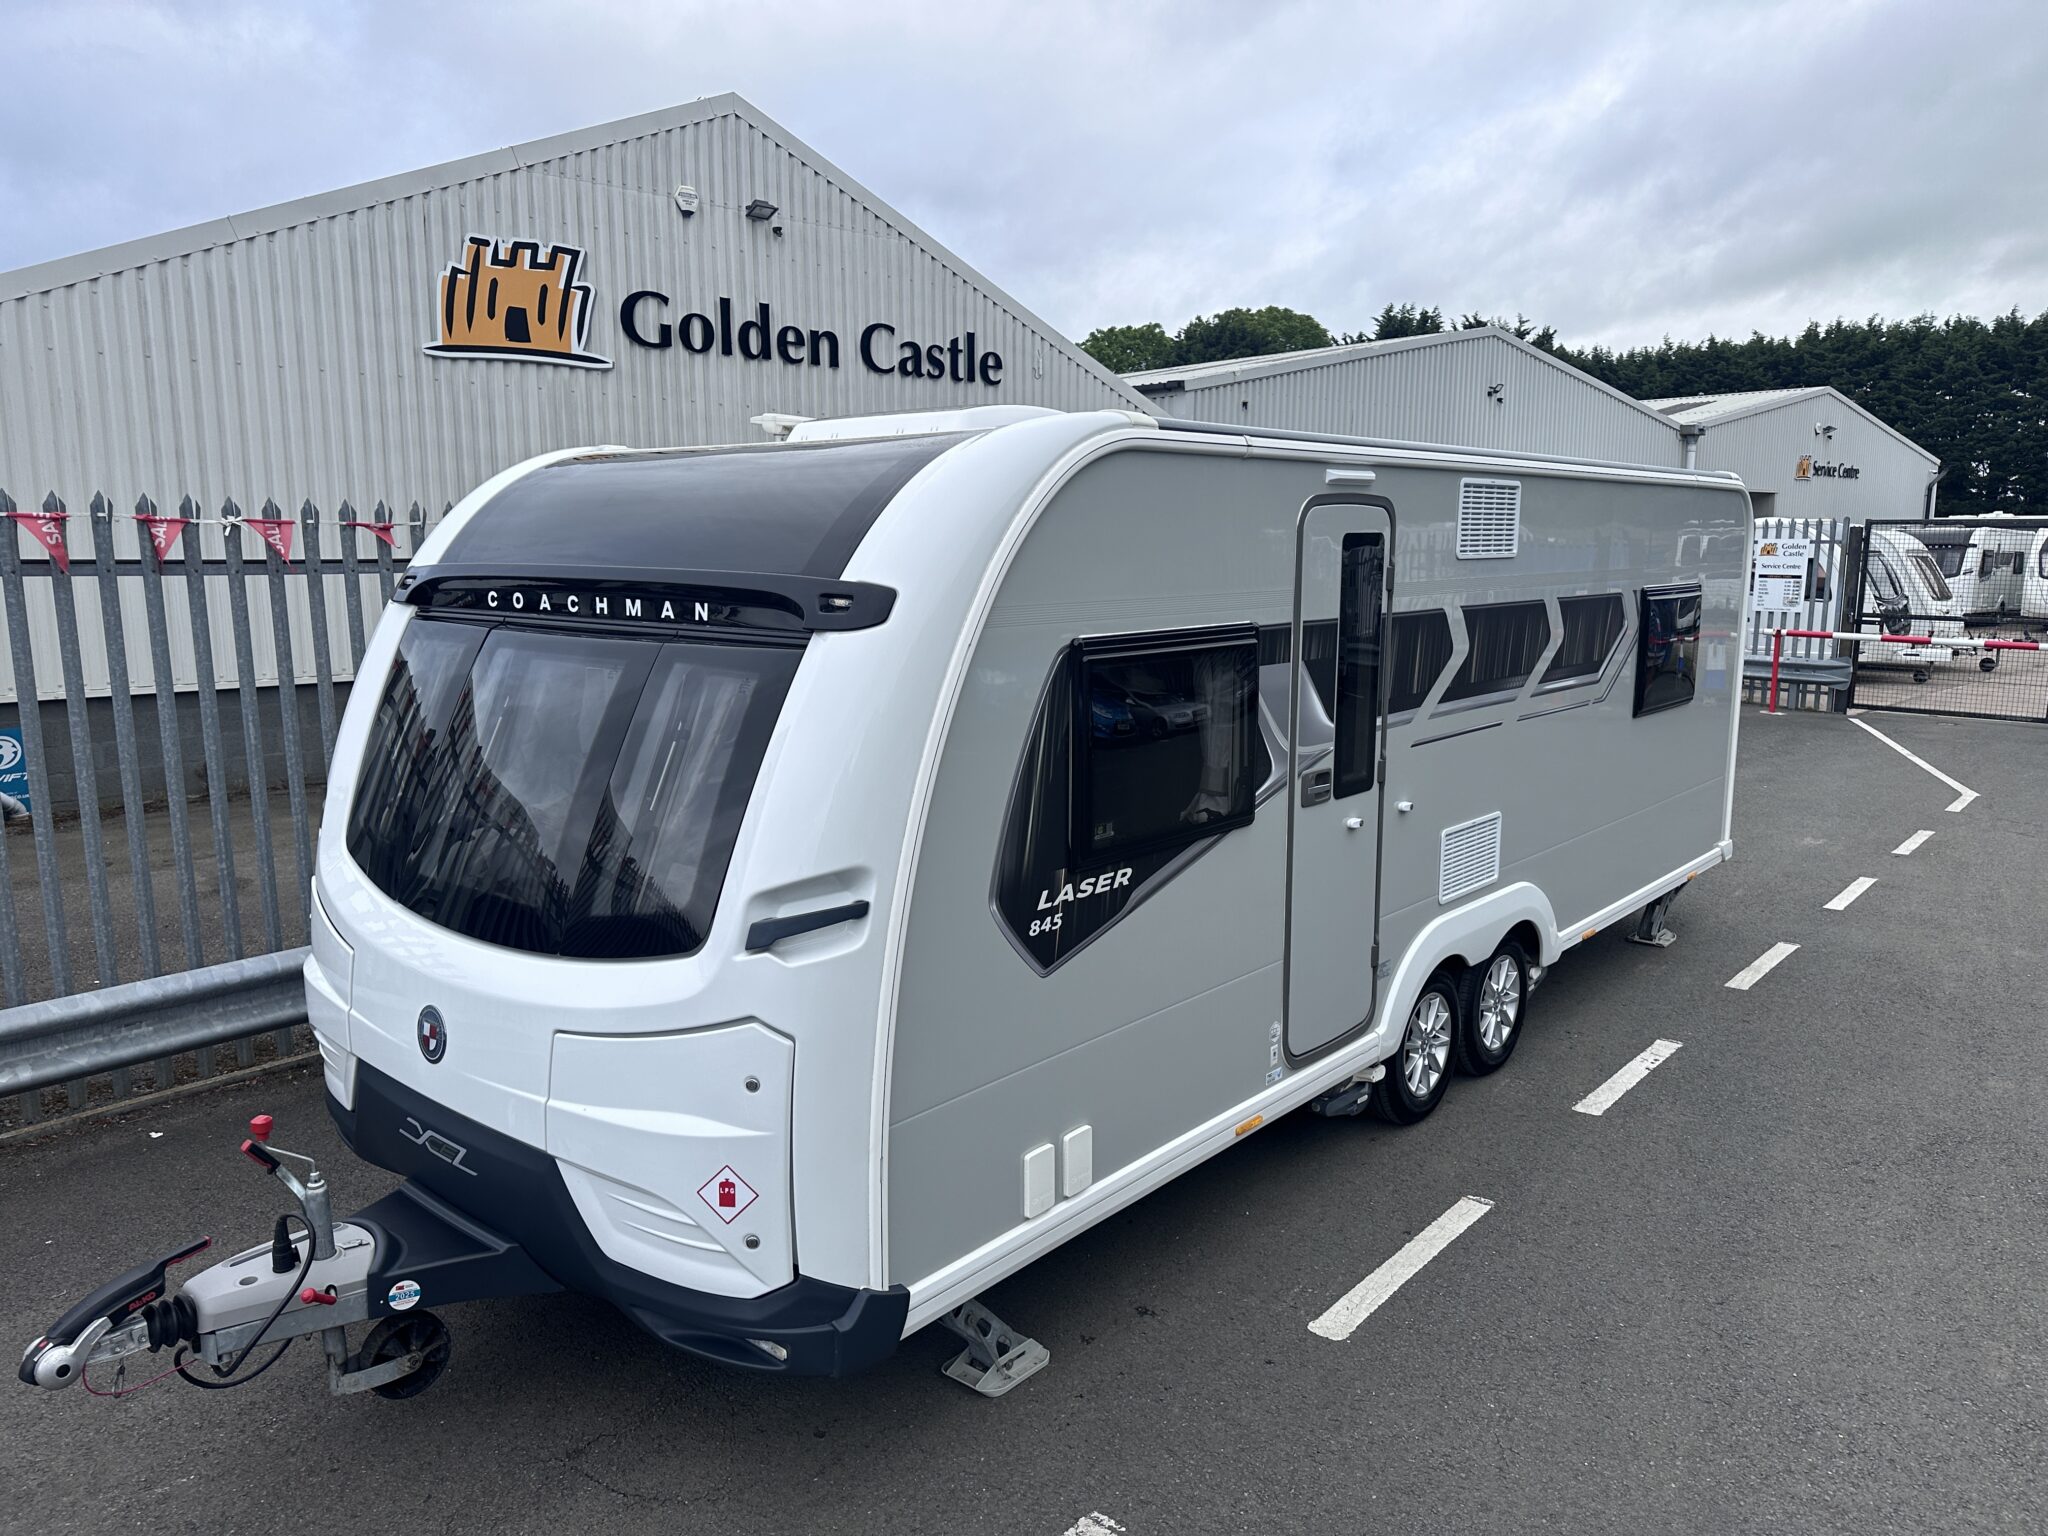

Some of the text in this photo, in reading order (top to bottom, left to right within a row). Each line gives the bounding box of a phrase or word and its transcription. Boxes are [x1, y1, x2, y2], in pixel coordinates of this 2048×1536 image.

[620, 290, 1003, 386] Golden Castle
[1812, 460, 1860, 479] Service Centre
[487, 590, 709, 622] COACHMAN
[1037, 867, 1133, 911] LASER
[1028, 912, 1063, 937] 845
[719, 1187, 735, 1195] LPG
[394, 1290, 415, 1301] 2025
